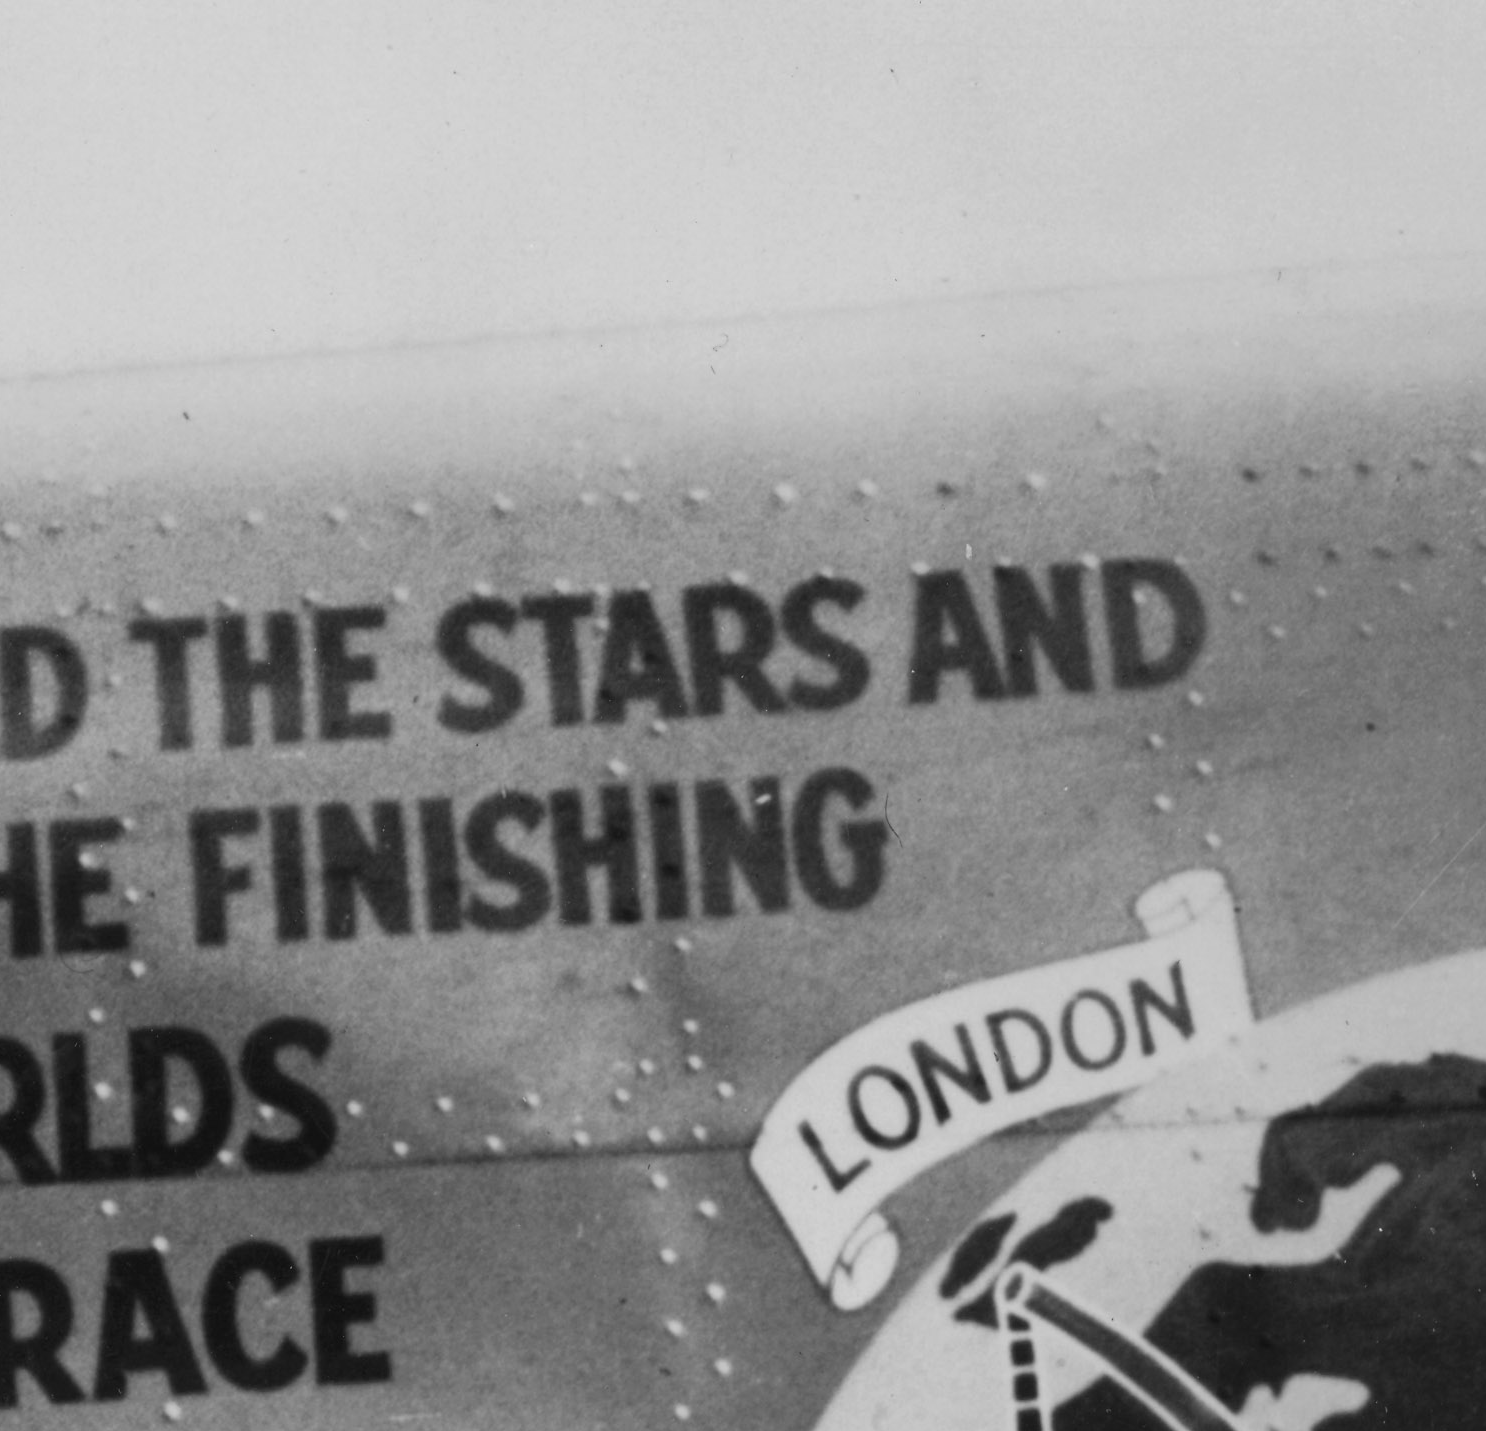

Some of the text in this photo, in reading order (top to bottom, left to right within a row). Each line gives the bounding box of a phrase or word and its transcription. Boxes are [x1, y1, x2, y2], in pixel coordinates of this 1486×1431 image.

[128, 603, 395, 752] THE
[435, 575, 873, 737] STARS
[907, 556, 1209, 706] AND
[188, 765, 889, 950] FINISHING
[797, 960, 1197, 1192] LONDON
